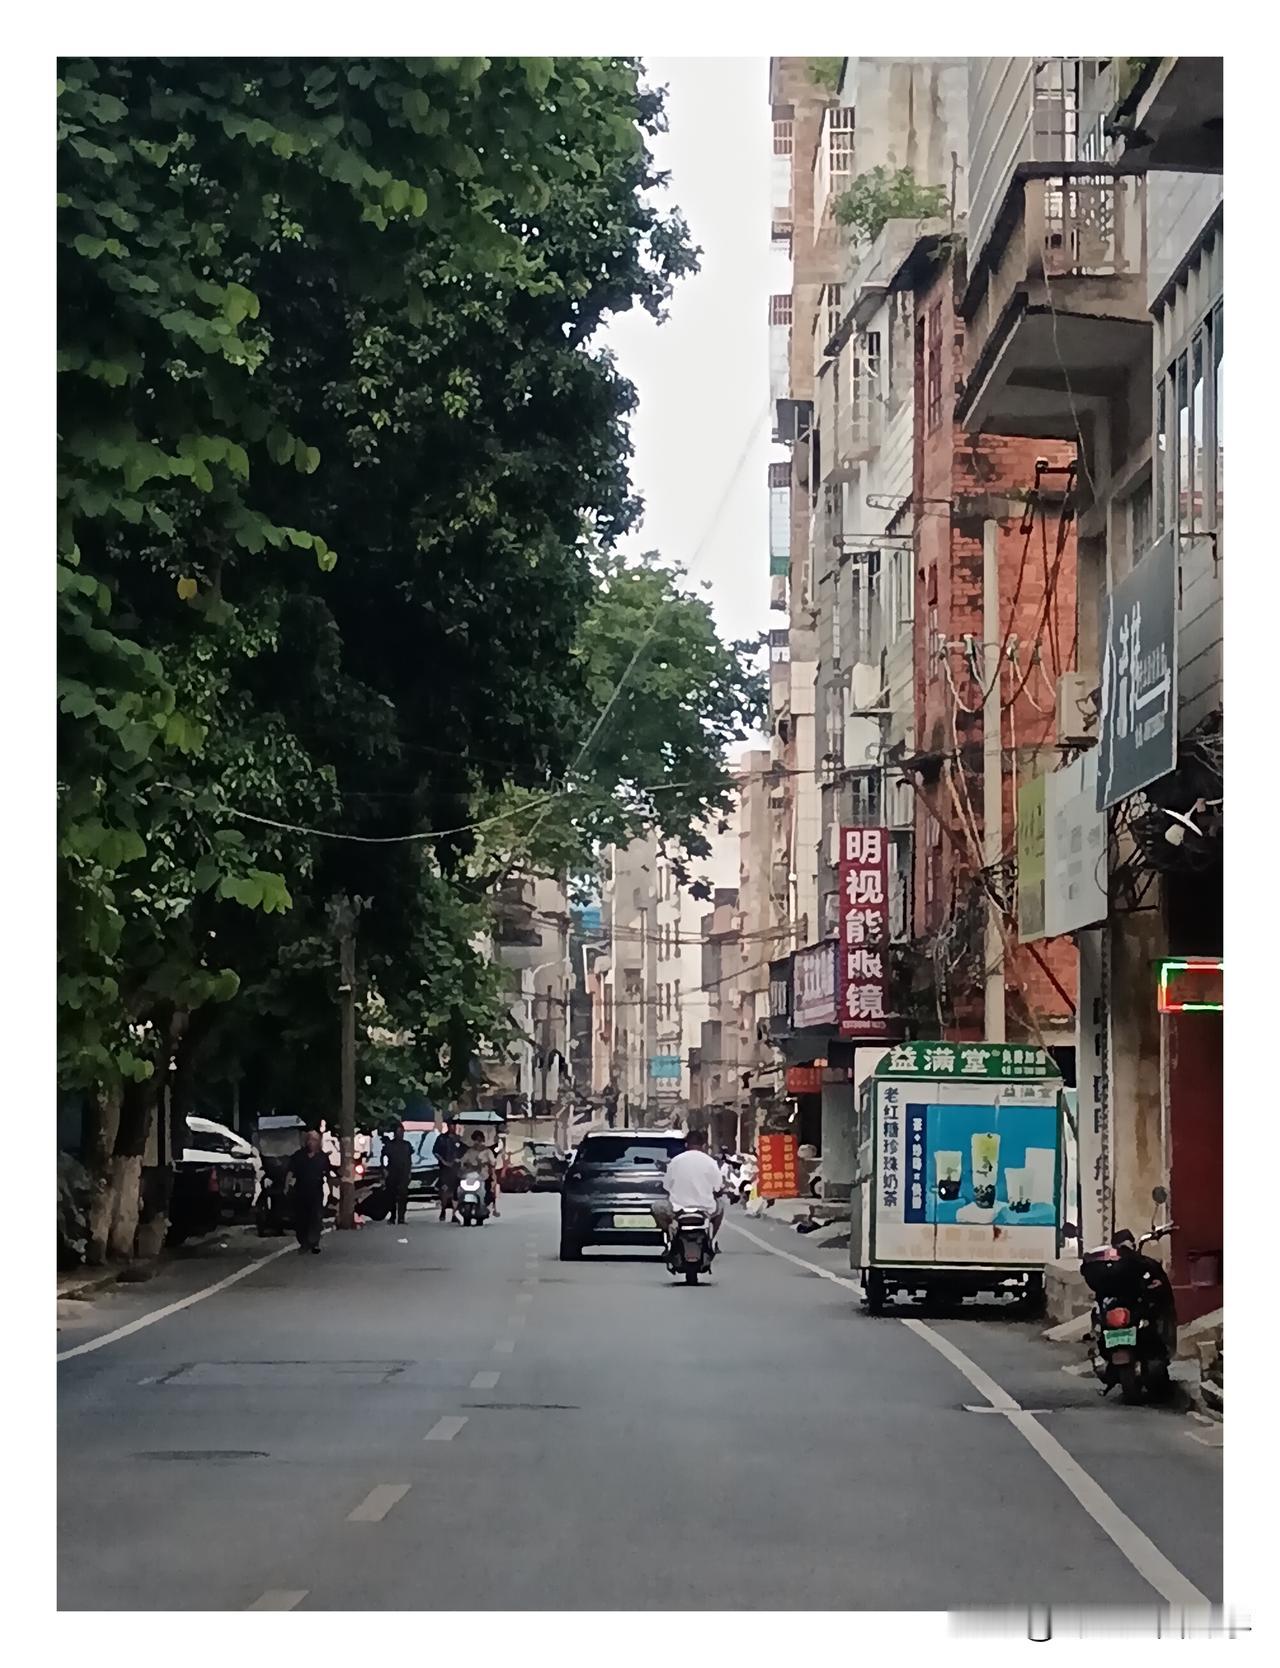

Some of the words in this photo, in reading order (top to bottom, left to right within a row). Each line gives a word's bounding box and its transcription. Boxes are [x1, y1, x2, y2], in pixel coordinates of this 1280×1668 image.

[846, 830, 884, 1019] 明视能眼镜
[888, 1045, 990, 1073] 益满堂
[883, 1087, 899, 1208] 老红糖珍珠奶茶
